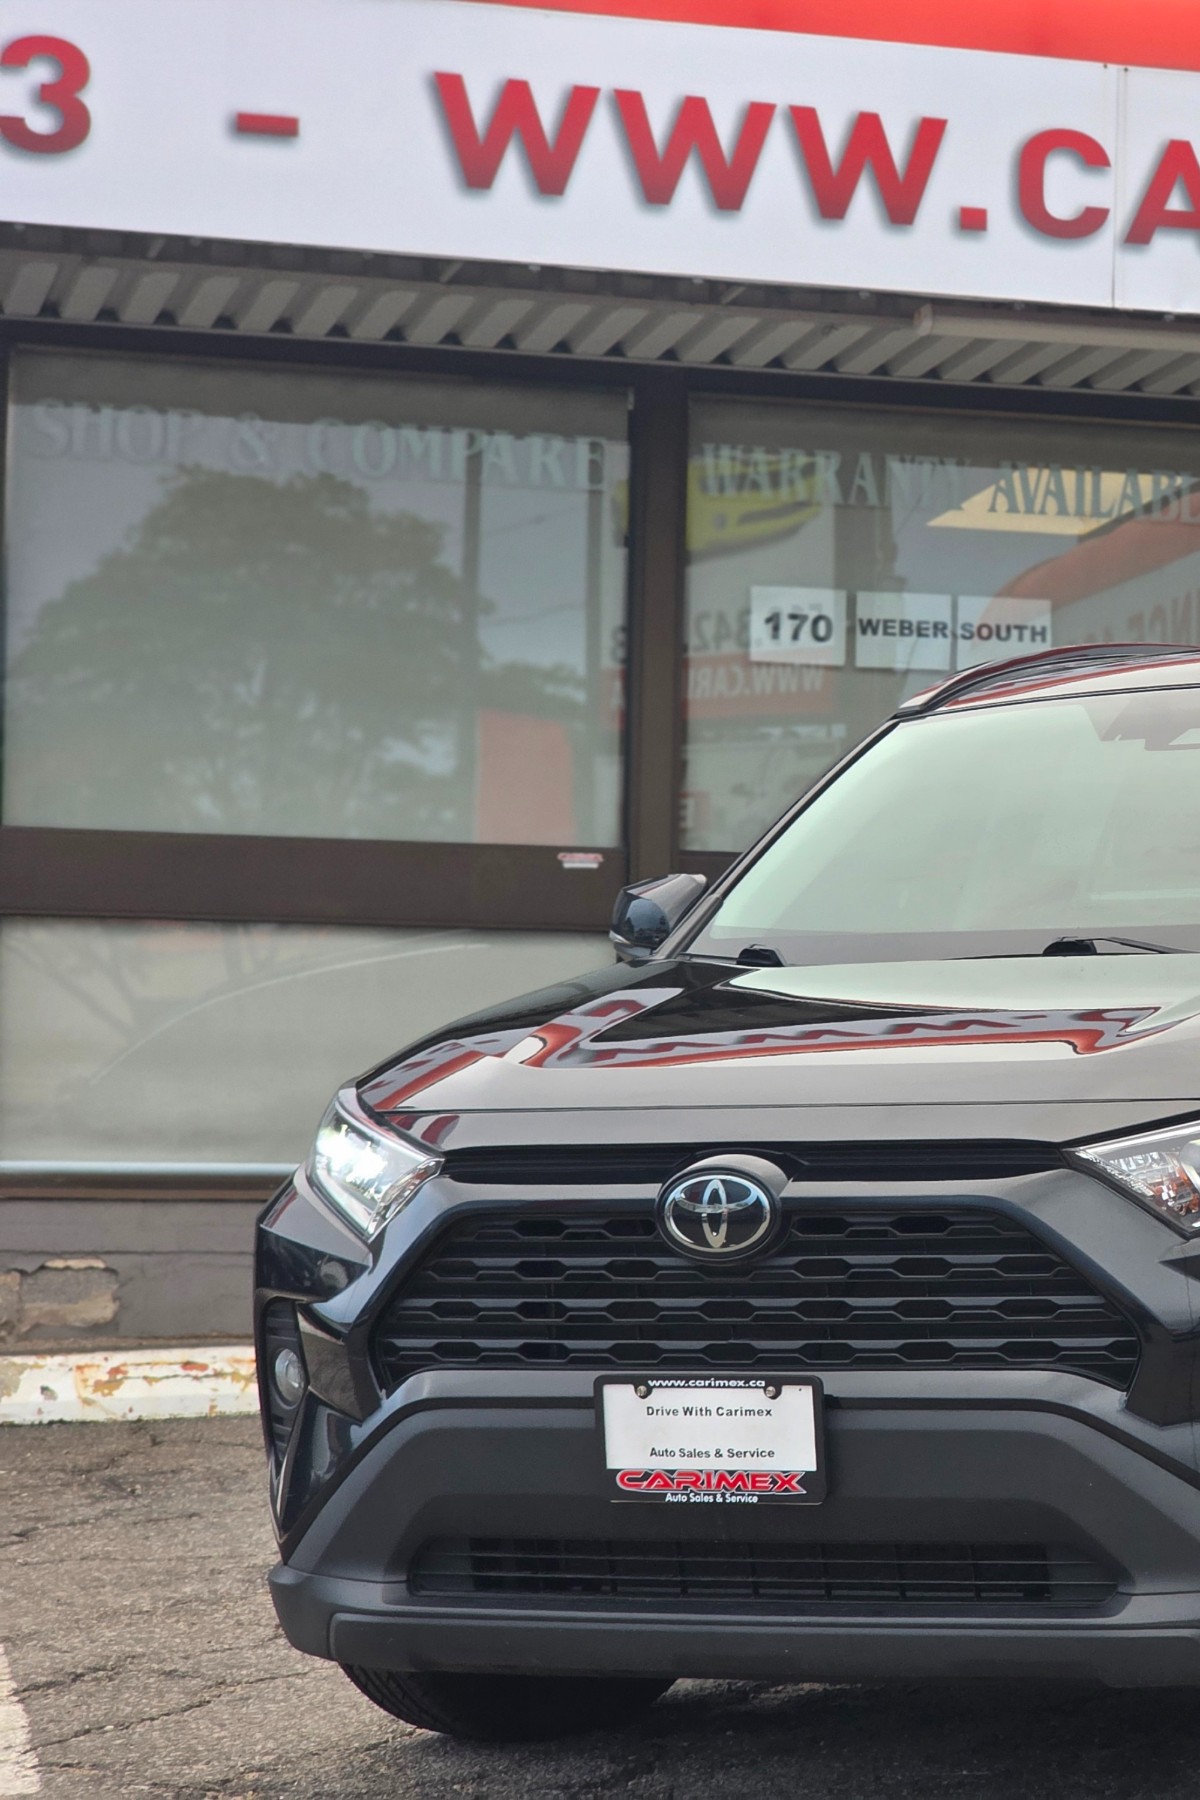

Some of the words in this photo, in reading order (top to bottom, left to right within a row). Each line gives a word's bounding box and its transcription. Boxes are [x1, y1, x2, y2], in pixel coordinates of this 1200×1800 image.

[33, 398, 200, 462] SHOP
[232, 410, 275, 470] &
[308, 416, 608, 490] COMPARE
[701, 442, 971, 511] WARRANTY
[763, 611, 834, 643] 170
[859, 617, 949, 639] WEBER
[959, 622, 1048, 644] SOUTH
[647, 1377, 766, 1388] www.carimex.ca
[646, 1406, 679, 1417] Drive
[682, 1406, 713, 1417] With
[716, 1406, 773, 1417] Carimex
[649, 1447, 676, 1458] Auto
[678, 1447, 711, 1458] Sales
[713, 1448, 724, 1458] &
[726, 1448, 775, 1459] Service
[616, 1469, 807, 1494] CARIMEX
[664, 1492, 689, 1503] Auto
[689, 1492, 714, 1503] Sales
[715, 1493, 724, 1503] &
[724, 1493, 759, 1504] Service
